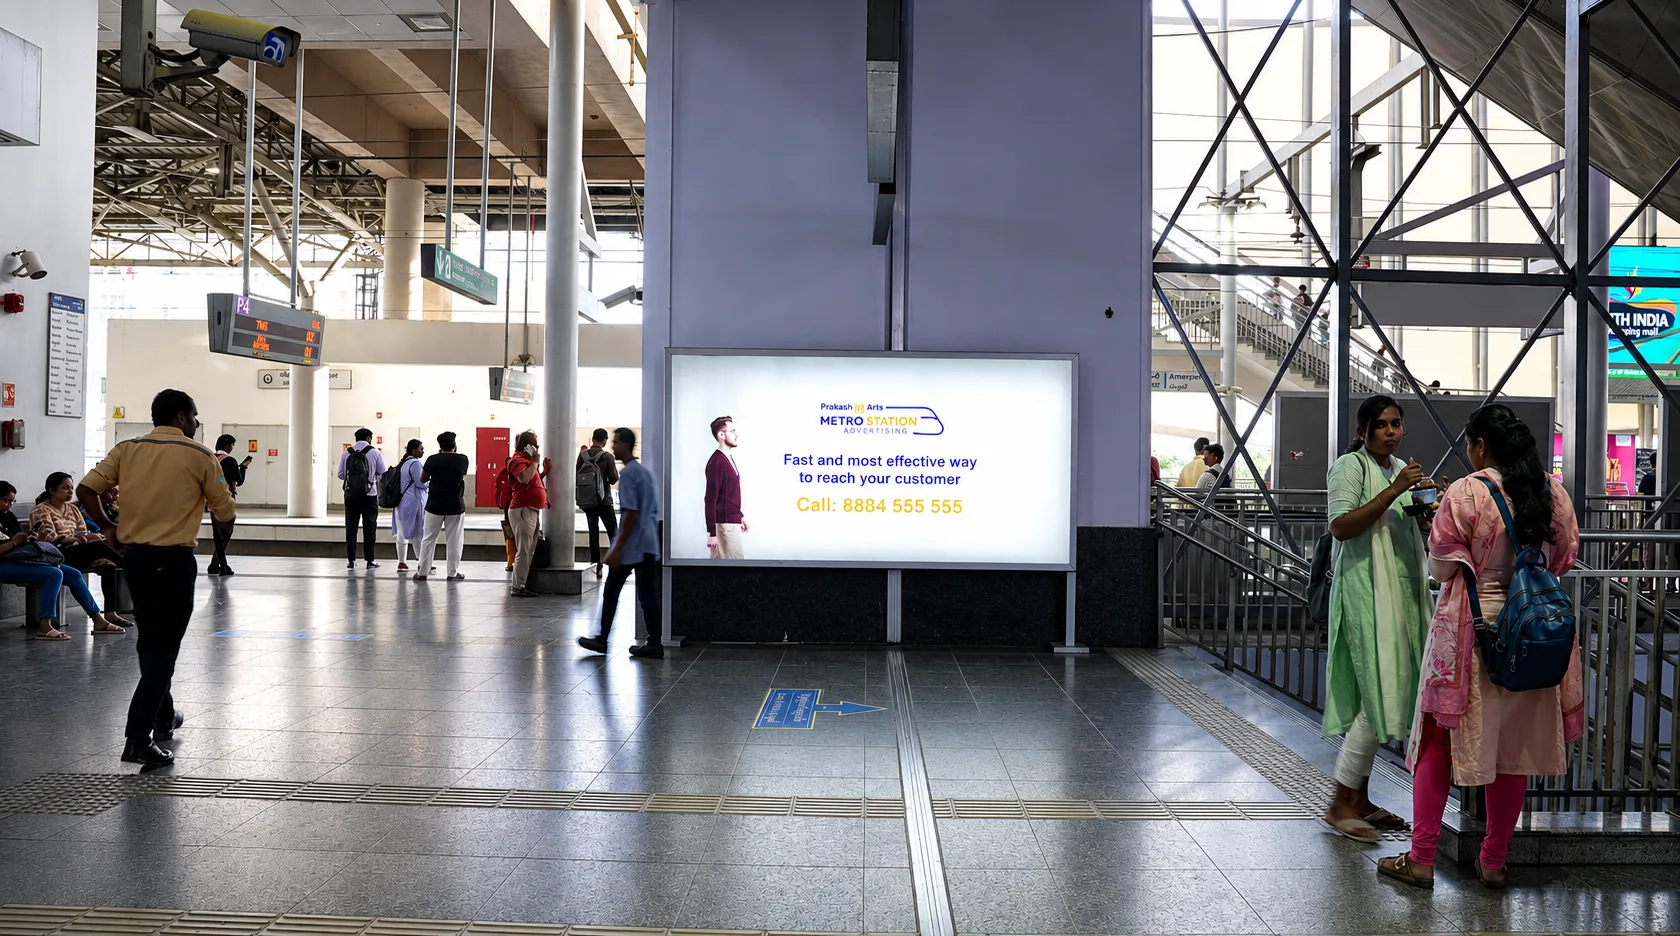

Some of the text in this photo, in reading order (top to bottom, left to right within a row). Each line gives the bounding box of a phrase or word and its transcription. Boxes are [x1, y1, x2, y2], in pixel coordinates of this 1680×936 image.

[237, 296, 250, 314] P4
[1633, 312, 1669, 327] INDIA
[820, 403, 853, 411] Prakash
[820, 416, 918, 427] METRO STATION
[843, 427, 908, 435] ADVERTISING
[784, 453, 978, 470] Fast and most effective way
[799, 471, 961, 487] to reach your customer
[796, 497, 964, 515] Call: 8884 555 555
